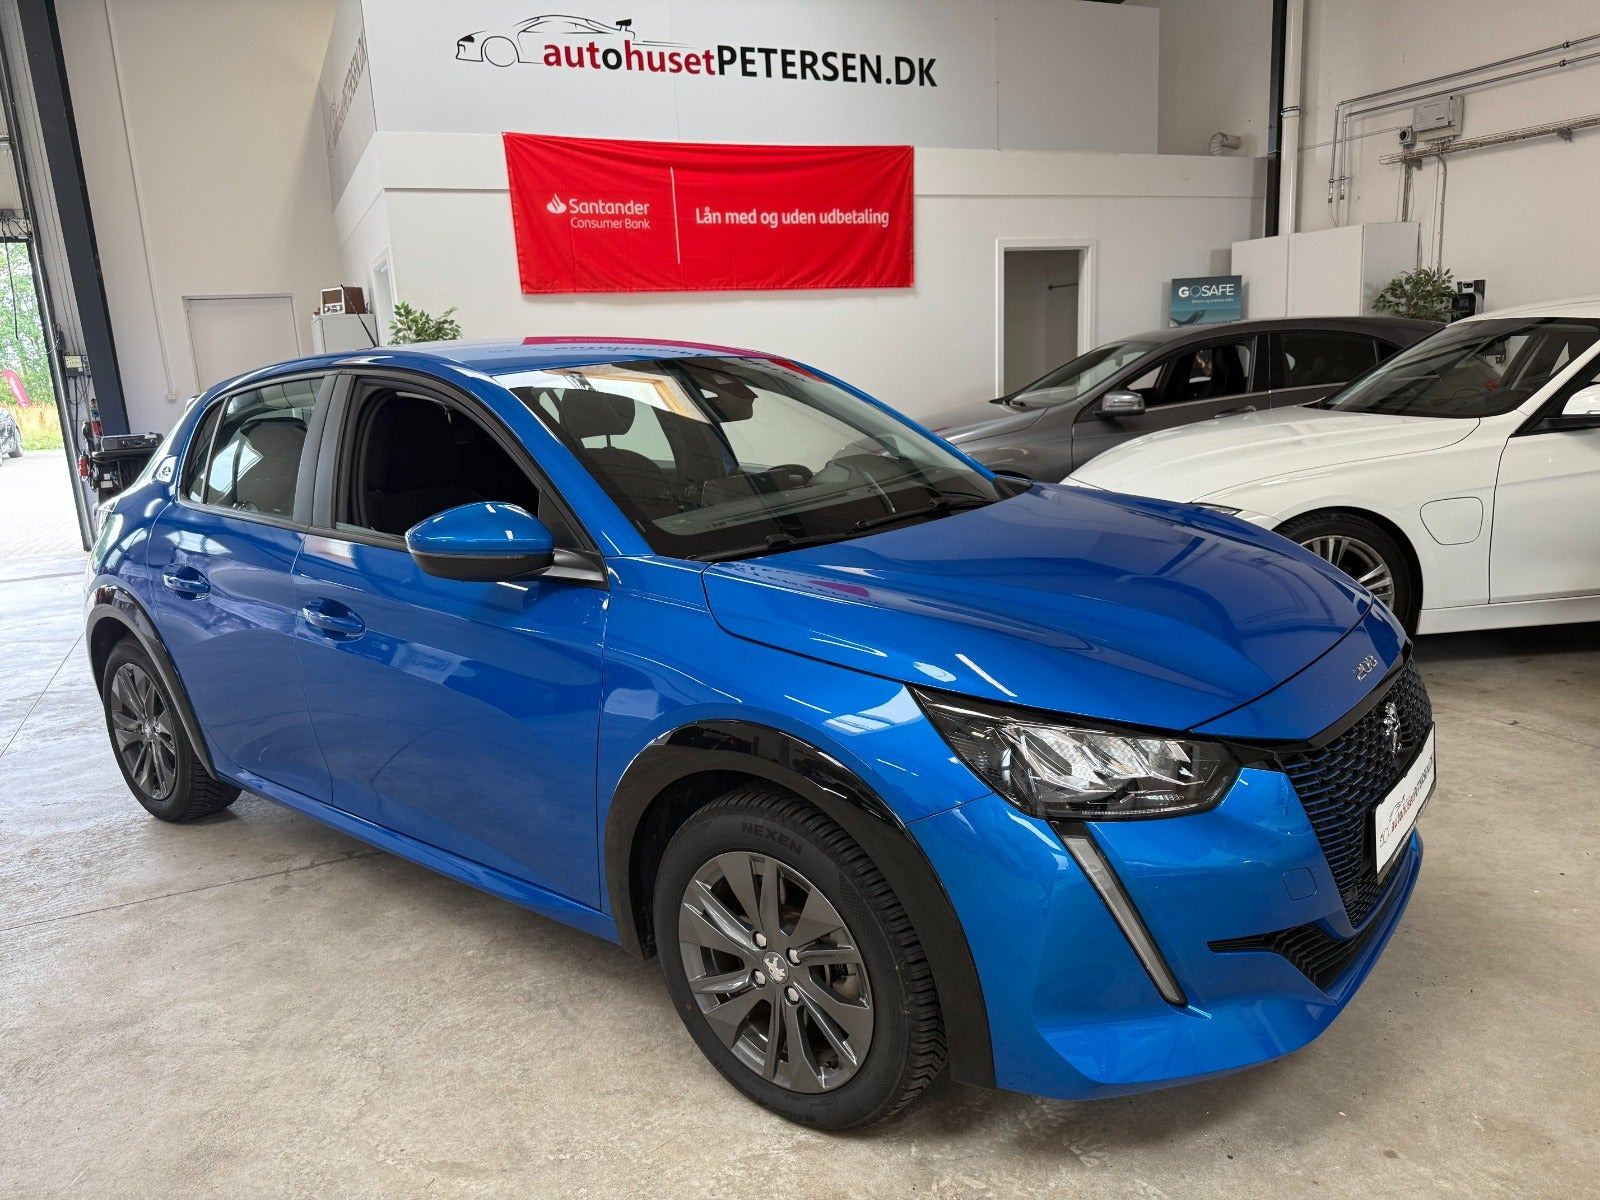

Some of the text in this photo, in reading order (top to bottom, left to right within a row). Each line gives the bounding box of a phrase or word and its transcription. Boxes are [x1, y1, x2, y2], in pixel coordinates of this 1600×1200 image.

[543, 40, 938, 88] autohusetPETERSEN.DK
[568, 198, 650, 215] Santander
[695, 206, 890, 229] Lån med og uden udbetaling
[570, 217, 651, 230] Consumer Bank
[1178, 283, 1235, 298] GOSAFE
[1352, 655, 1378, 682] 208
[740, 821, 804, 855] NEXEN
